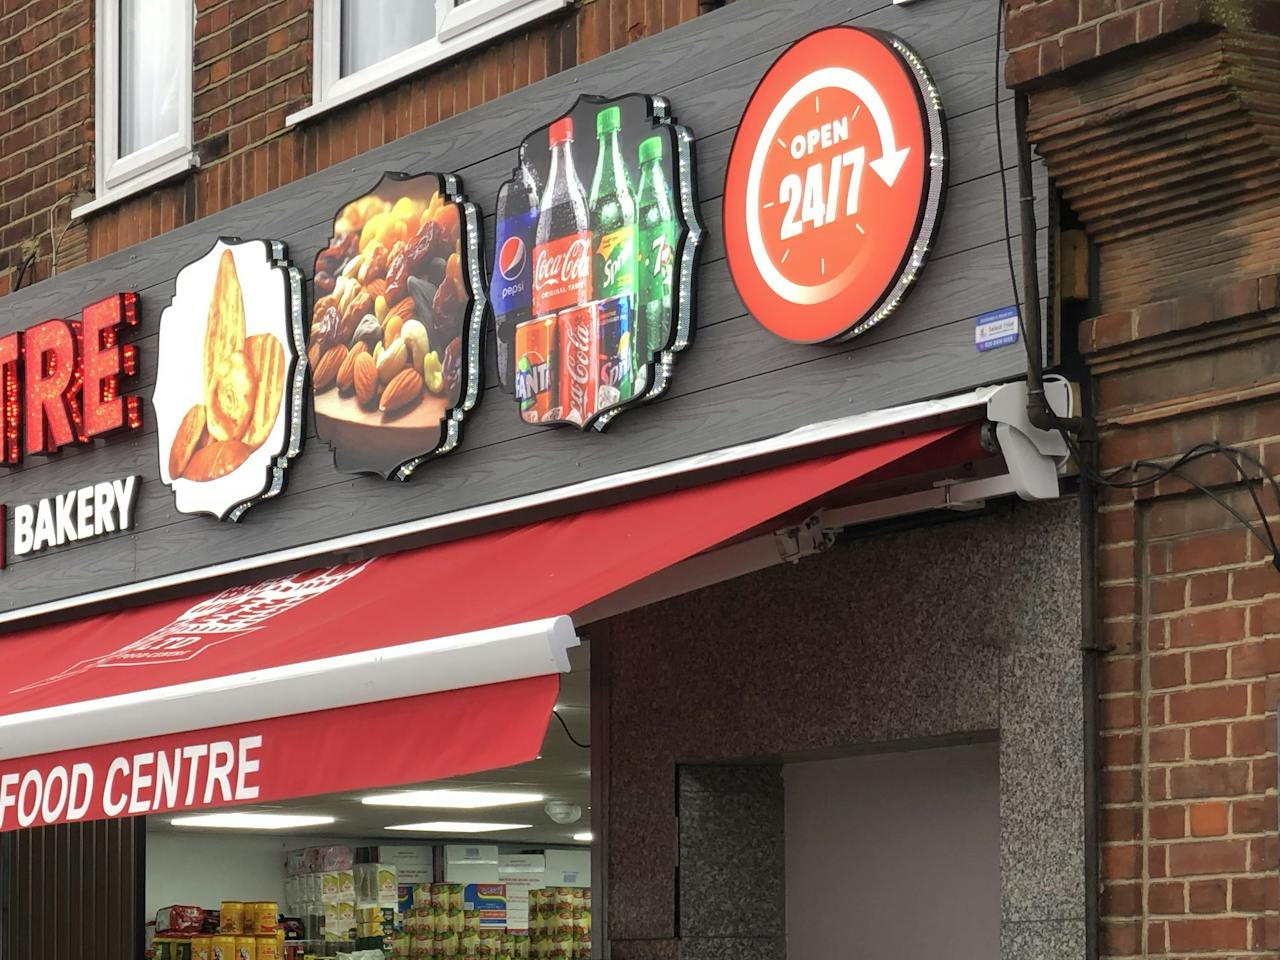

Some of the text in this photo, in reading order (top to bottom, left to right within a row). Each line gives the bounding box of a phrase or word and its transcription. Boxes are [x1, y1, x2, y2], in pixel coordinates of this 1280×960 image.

[790, 117, 849, 160] OPEN
[780, 147, 866, 241] 24/7
[502, 284, 524, 299] pepsi
[13, 475, 142, 555] BAKERY
[104, 735, 263, 818] CENTRE
